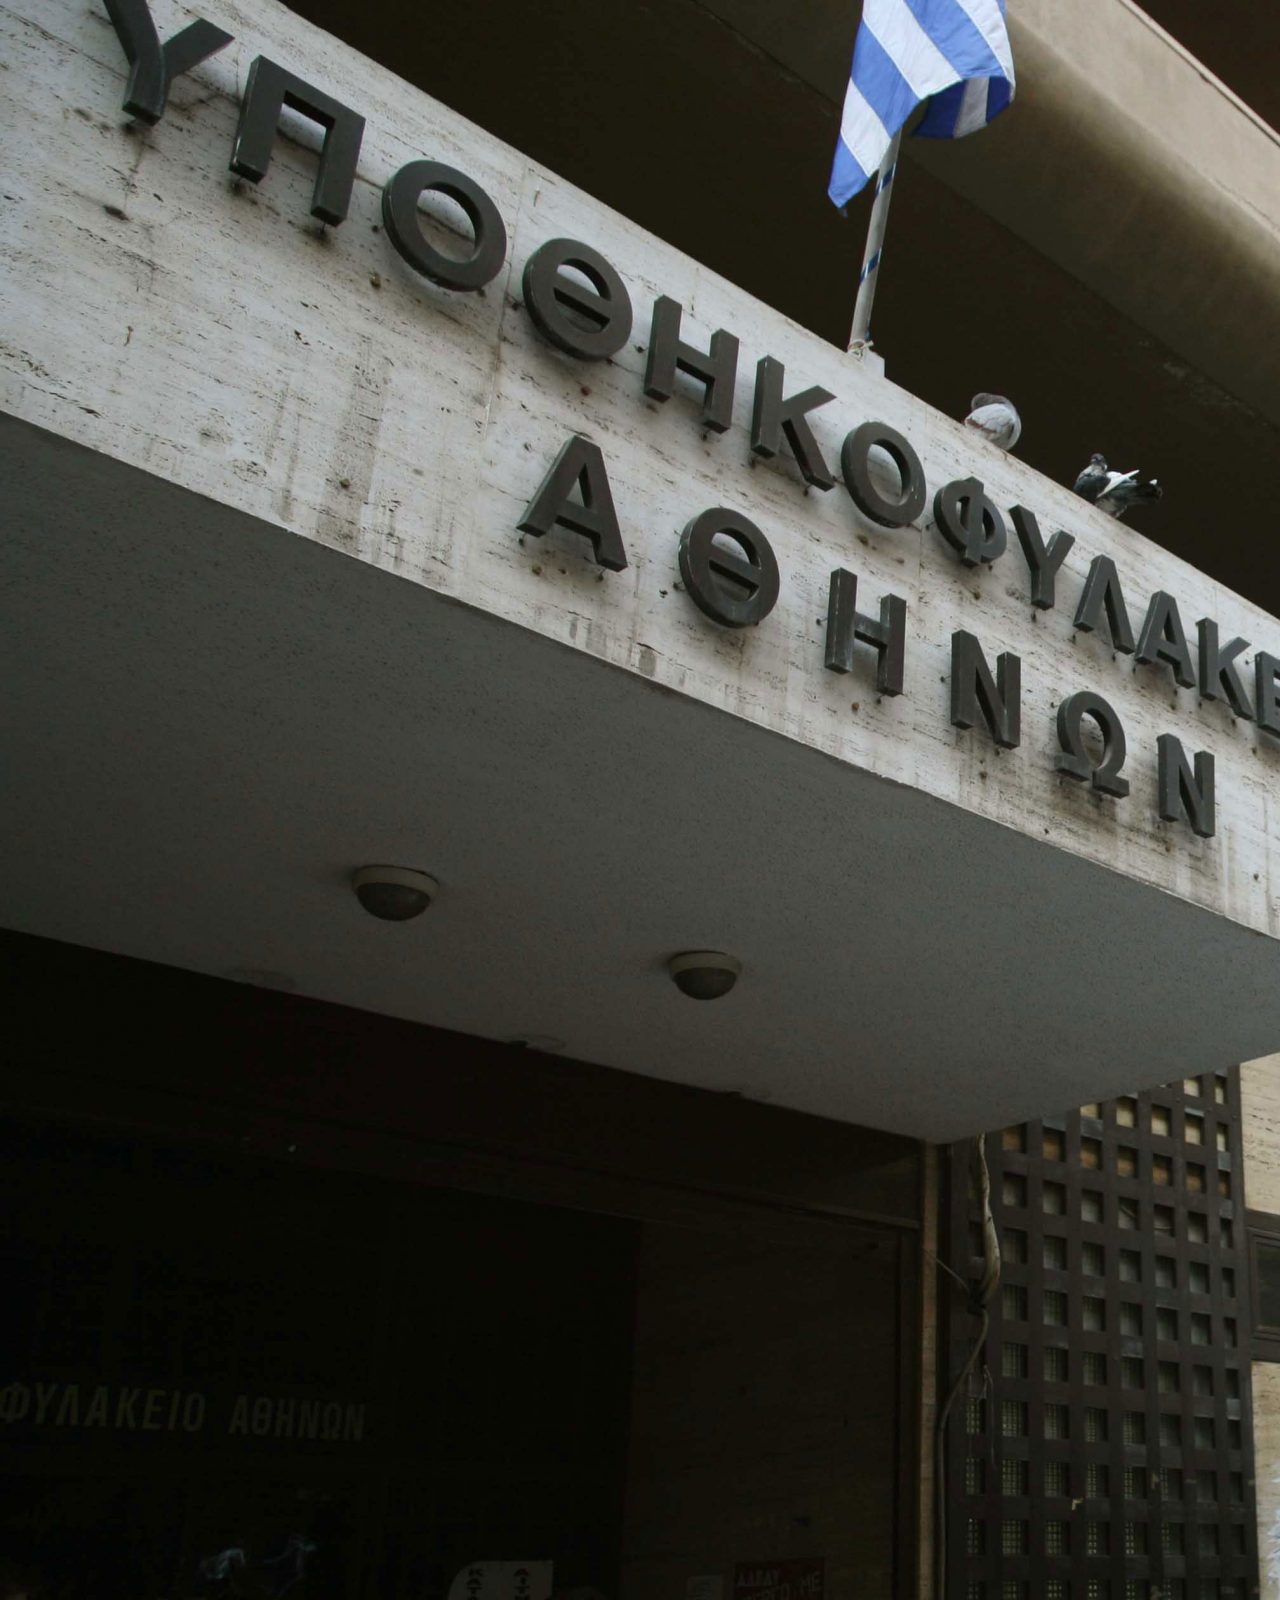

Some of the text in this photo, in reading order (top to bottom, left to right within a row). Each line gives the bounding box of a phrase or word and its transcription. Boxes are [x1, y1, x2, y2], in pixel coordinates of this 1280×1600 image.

[516, 433, 1216, 838] ΑΘΗΝΩΝ
[0, 1379, 367, 1441] ΦΥΛΑΚΕΙΟ ΑΘΗΝΩΝ
